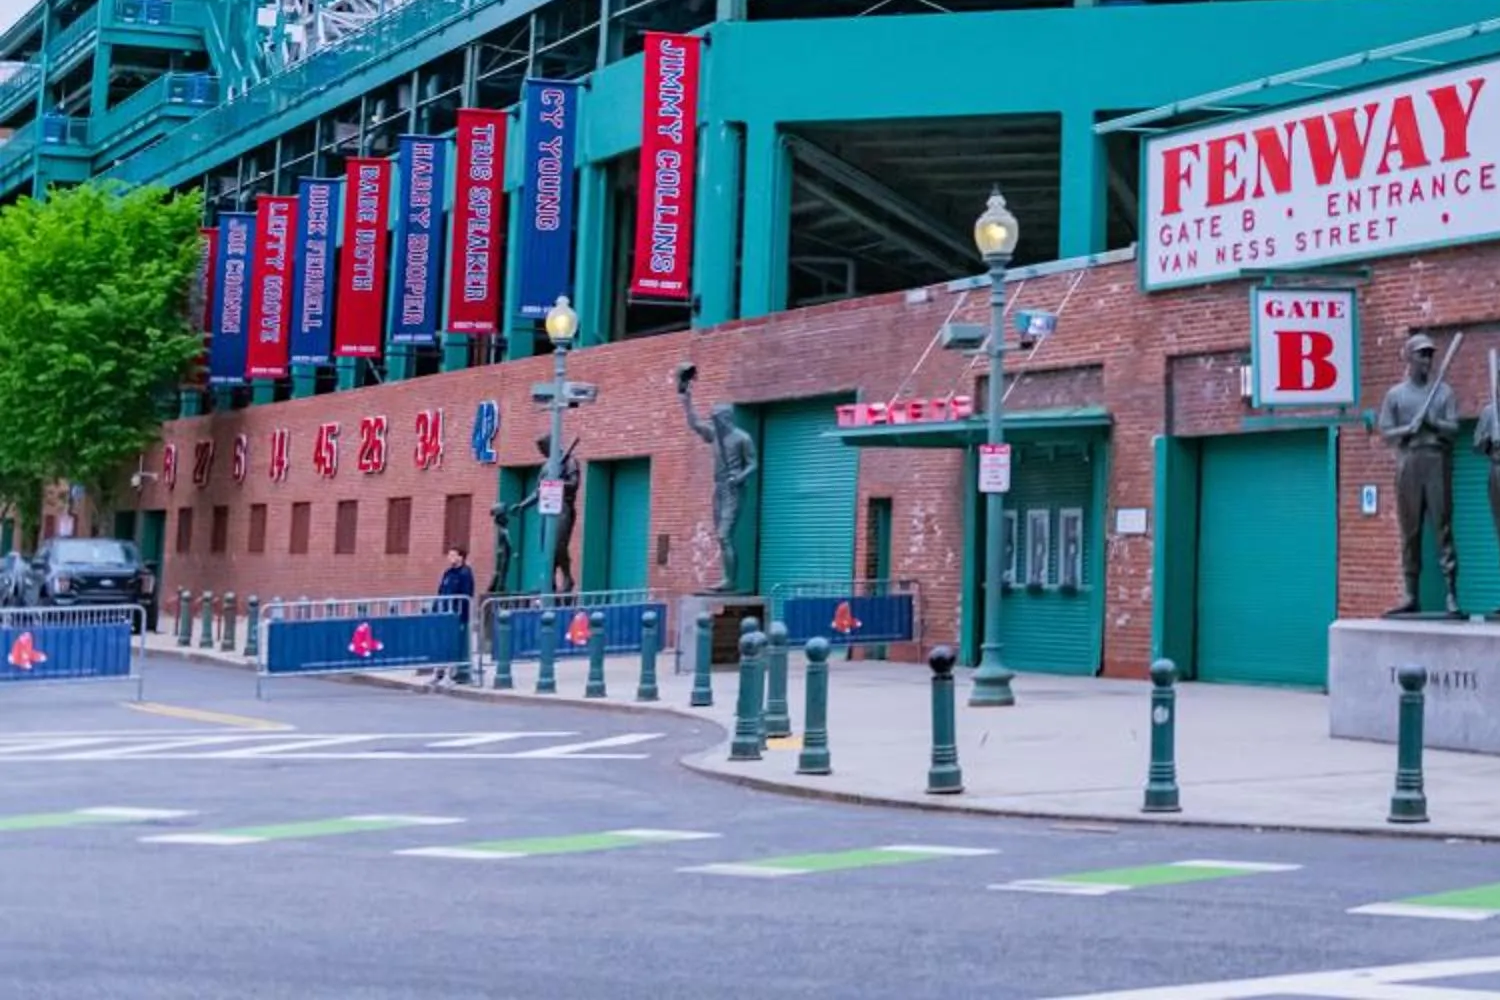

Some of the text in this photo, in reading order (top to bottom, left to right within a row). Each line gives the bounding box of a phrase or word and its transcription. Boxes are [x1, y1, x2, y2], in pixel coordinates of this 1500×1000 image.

[657, 39, 686, 144] JIMMY
[535, 89, 565, 231] CY YOUNG
[1160, 78, 1487, 217] FENWAY
[649, 149, 682, 275] COLLINS
[1159, 215, 1223, 247] GATE
[1242, 208, 1257, 234] B
[1326, 163, 1497, 218] ENTRANCE
[464, 187, 492, 303] SPEAKER
[1158, 252, 1199, 274] VAN
[1215, 237, 1276, 265] NESS
[1294, 216, 1399, 251] STREET
[1265, 298, 1345, 320] GATE
[1273, 330, 1339, 392] B
[313, 421, 338, 479] 45
[358, 415, 387, 473] 26
[415, 408, 444, 469] 34
[471, 400, 498, 464] 42
